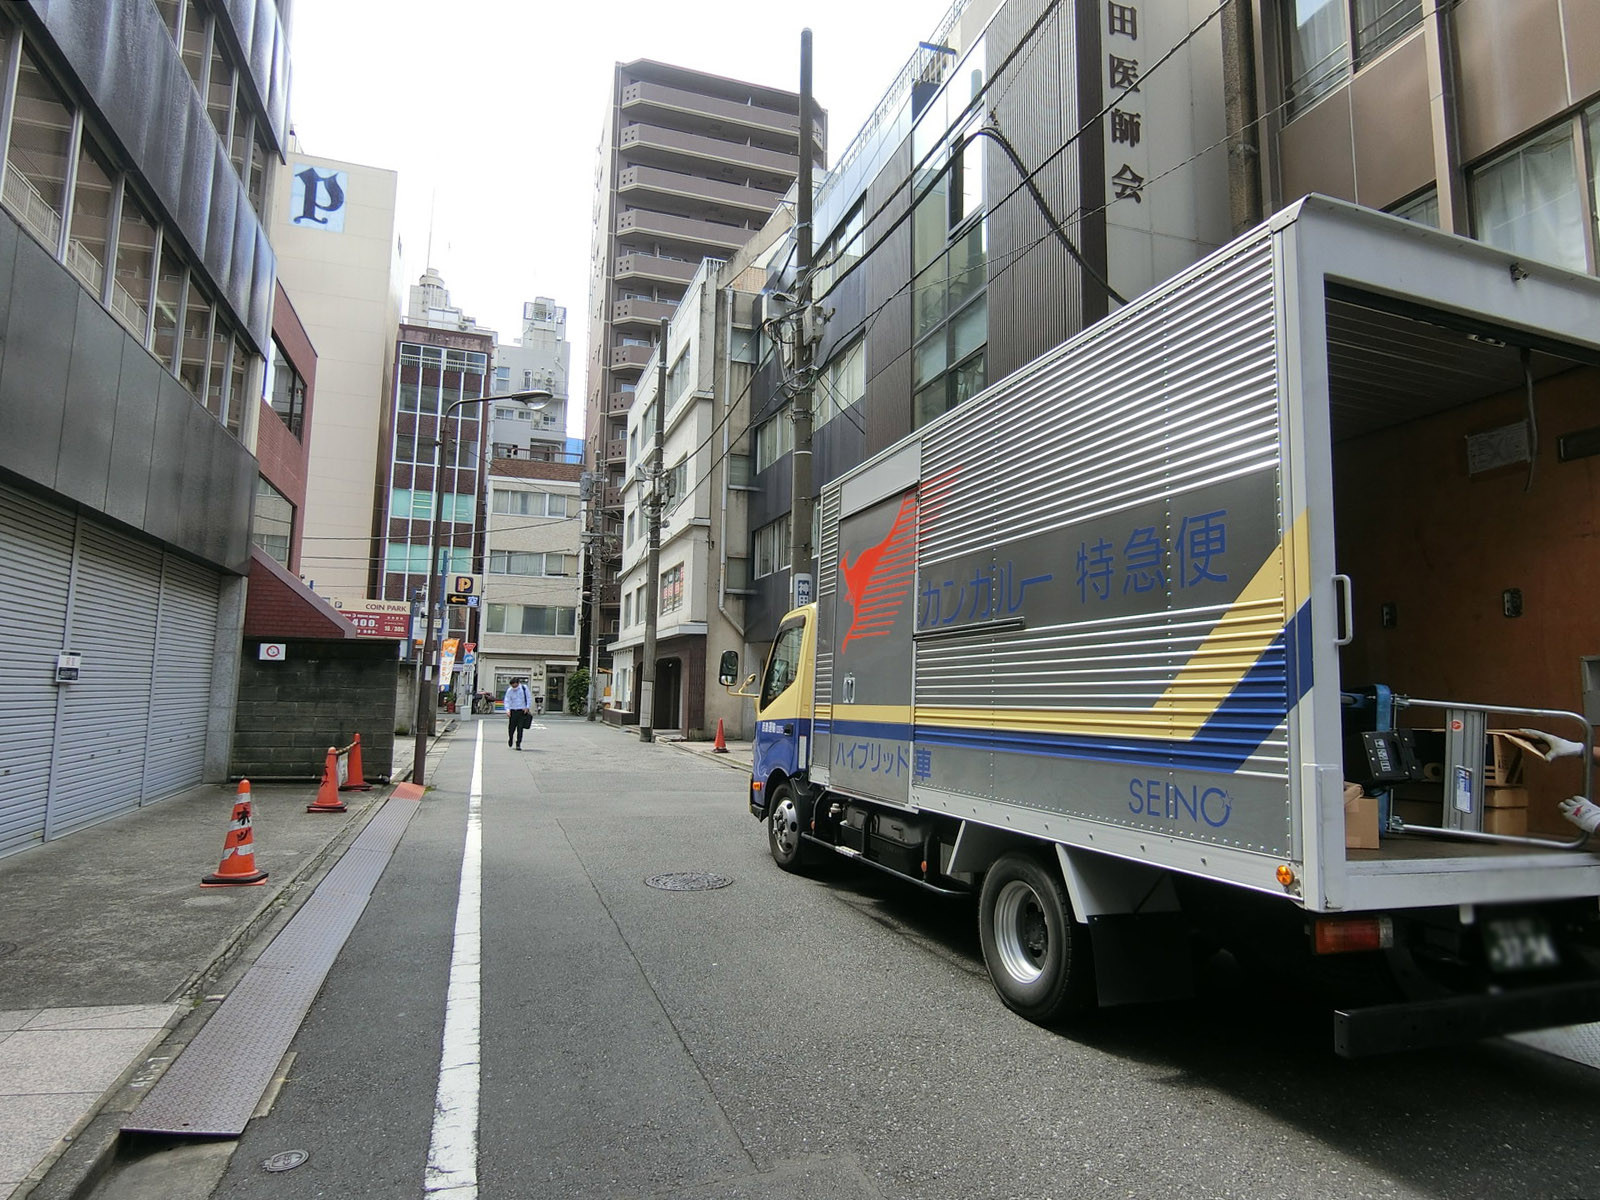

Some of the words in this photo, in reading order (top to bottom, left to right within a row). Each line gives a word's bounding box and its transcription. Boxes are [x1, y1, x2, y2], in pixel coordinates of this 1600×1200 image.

[921, 558, 1053, 627] カンガルー
[1076, 509, 1229, 604] 特急便
[365, 603, 385, 611] COIN
[386, 604, 407, 612] PARK
[834, 740, 932, 783] ハイブリッド車
[1128, 777, 1233, 828] SEINO
